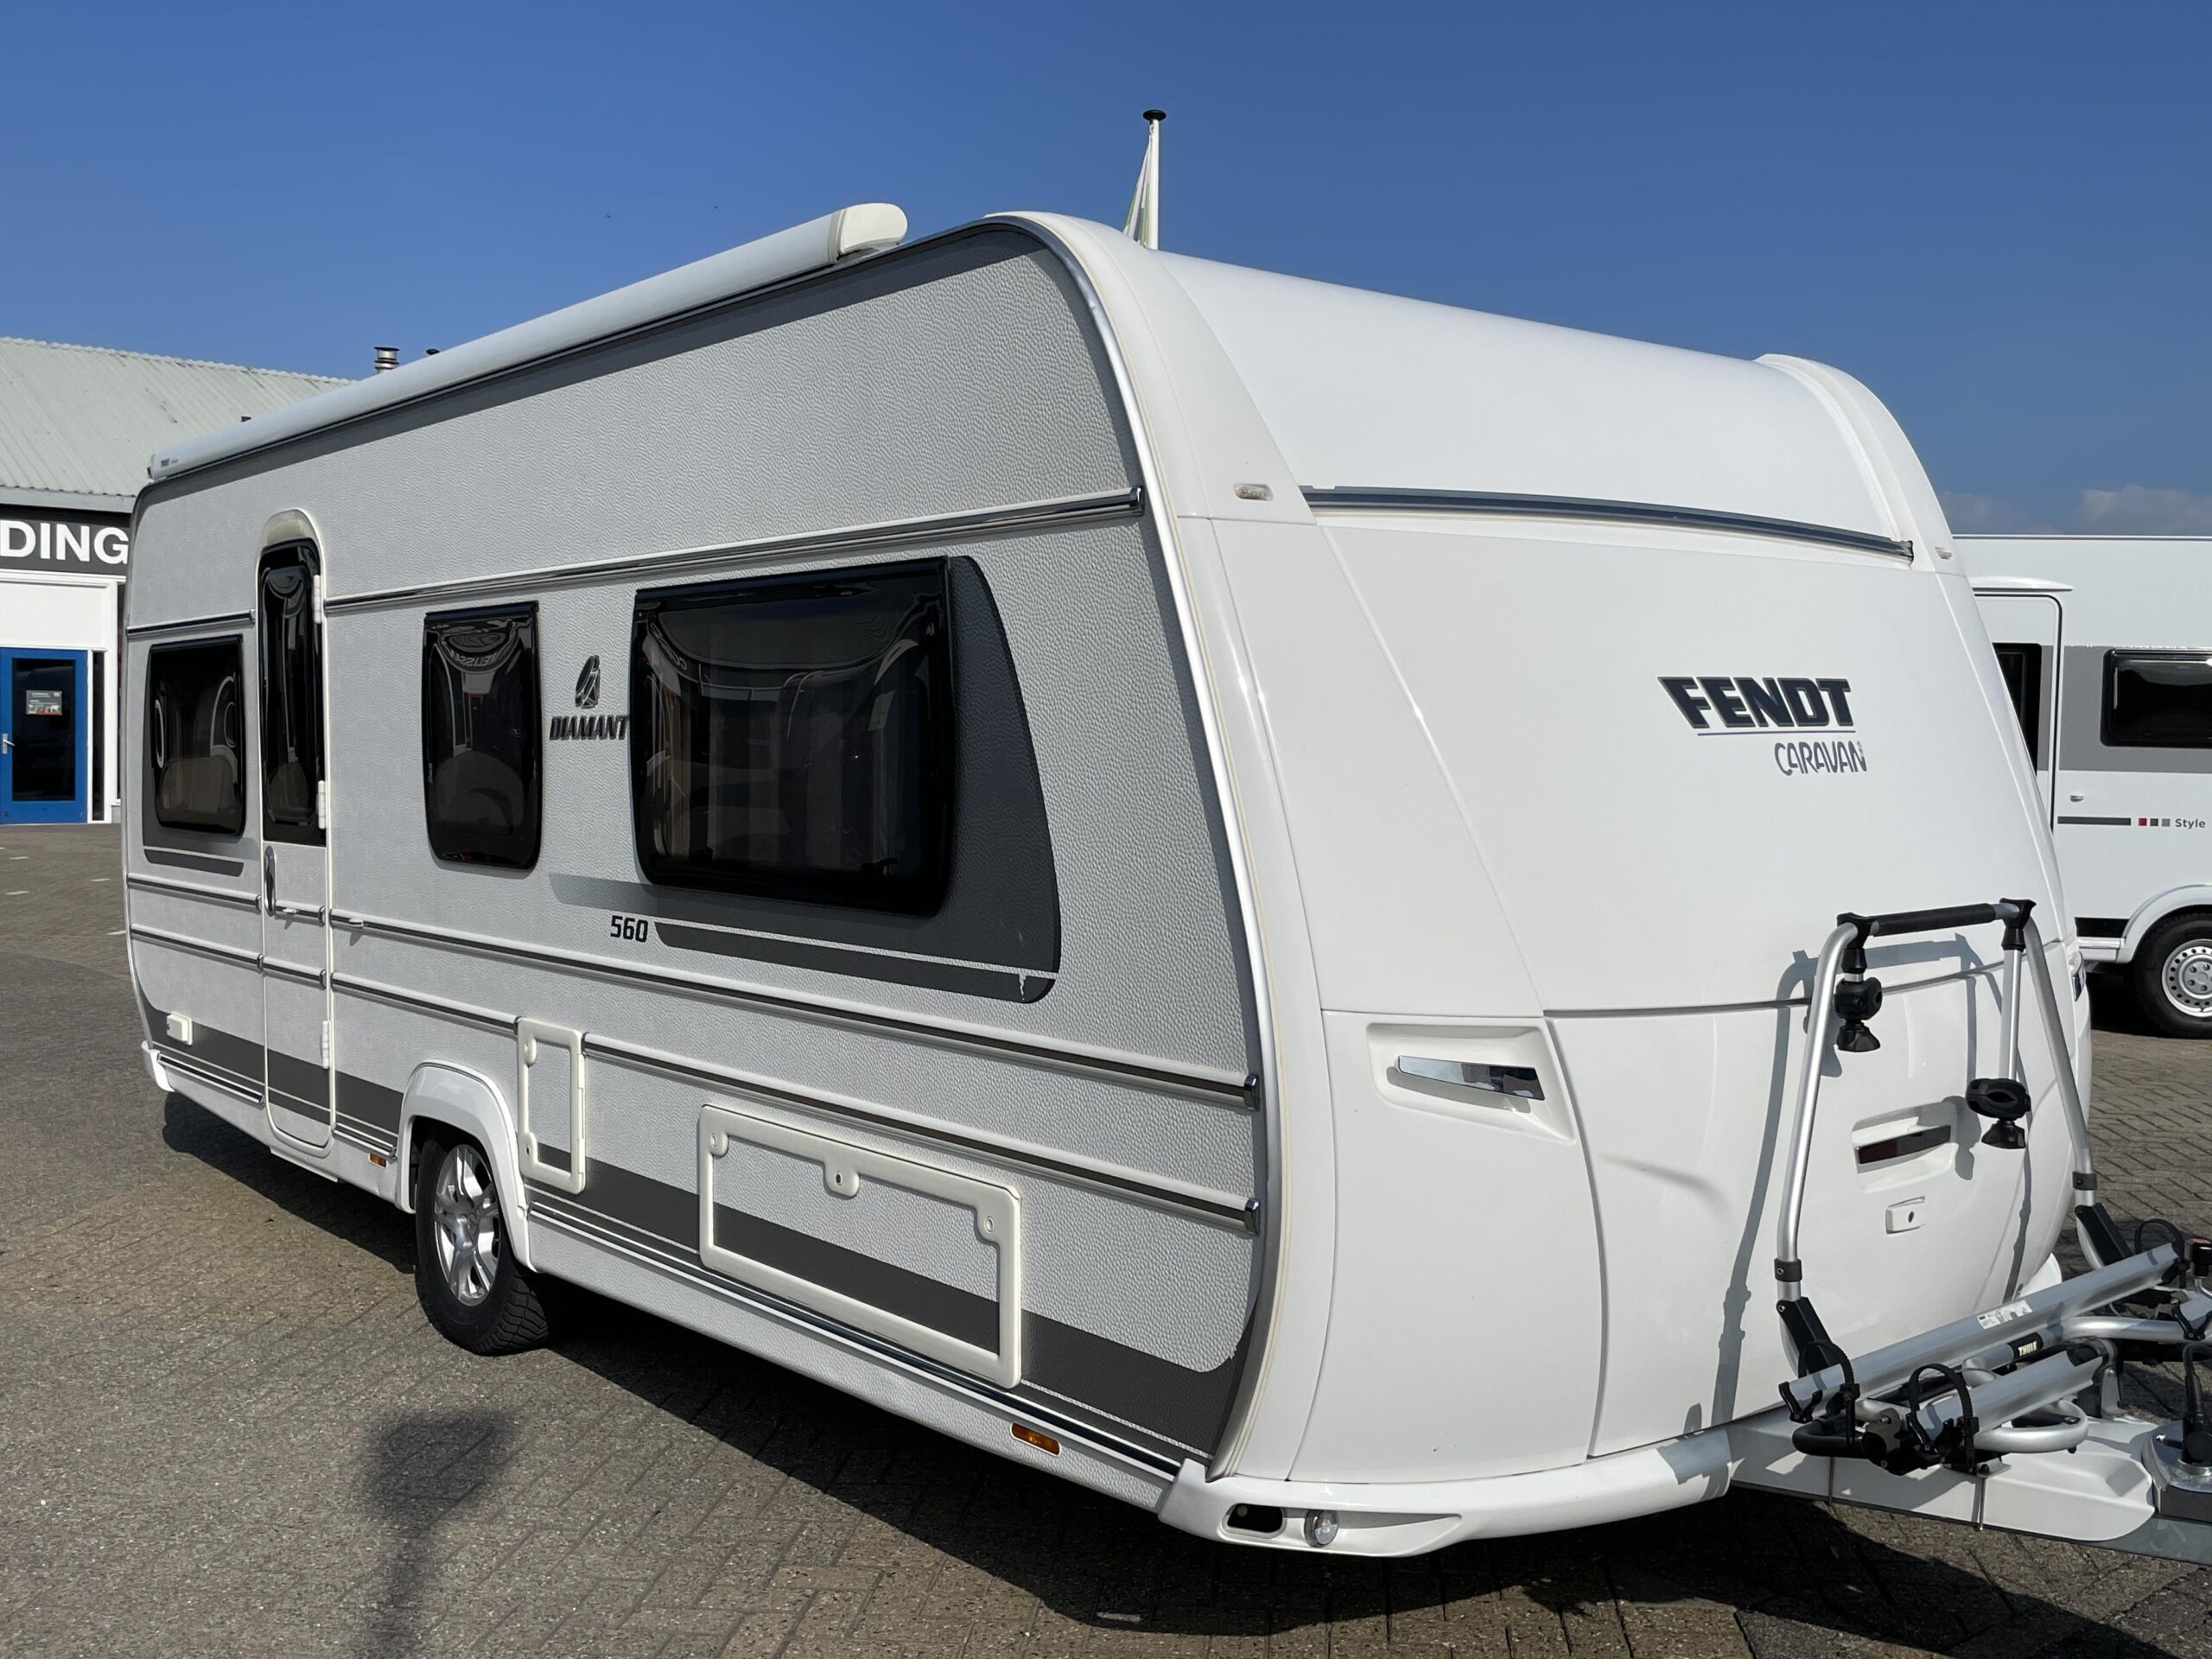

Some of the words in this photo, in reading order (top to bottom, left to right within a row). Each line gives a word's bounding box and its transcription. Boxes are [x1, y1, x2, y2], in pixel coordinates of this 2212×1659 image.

[0, 519, 130, 564] DING
[1657, 677, 1854, 728] FENDT
[549, 715, 630, 741] DIAMANT
[1774, 741, 1867, 776] CARAVAN
[2175, 818, 2206, 830] Style
[610, 914, 649, 943] 560
